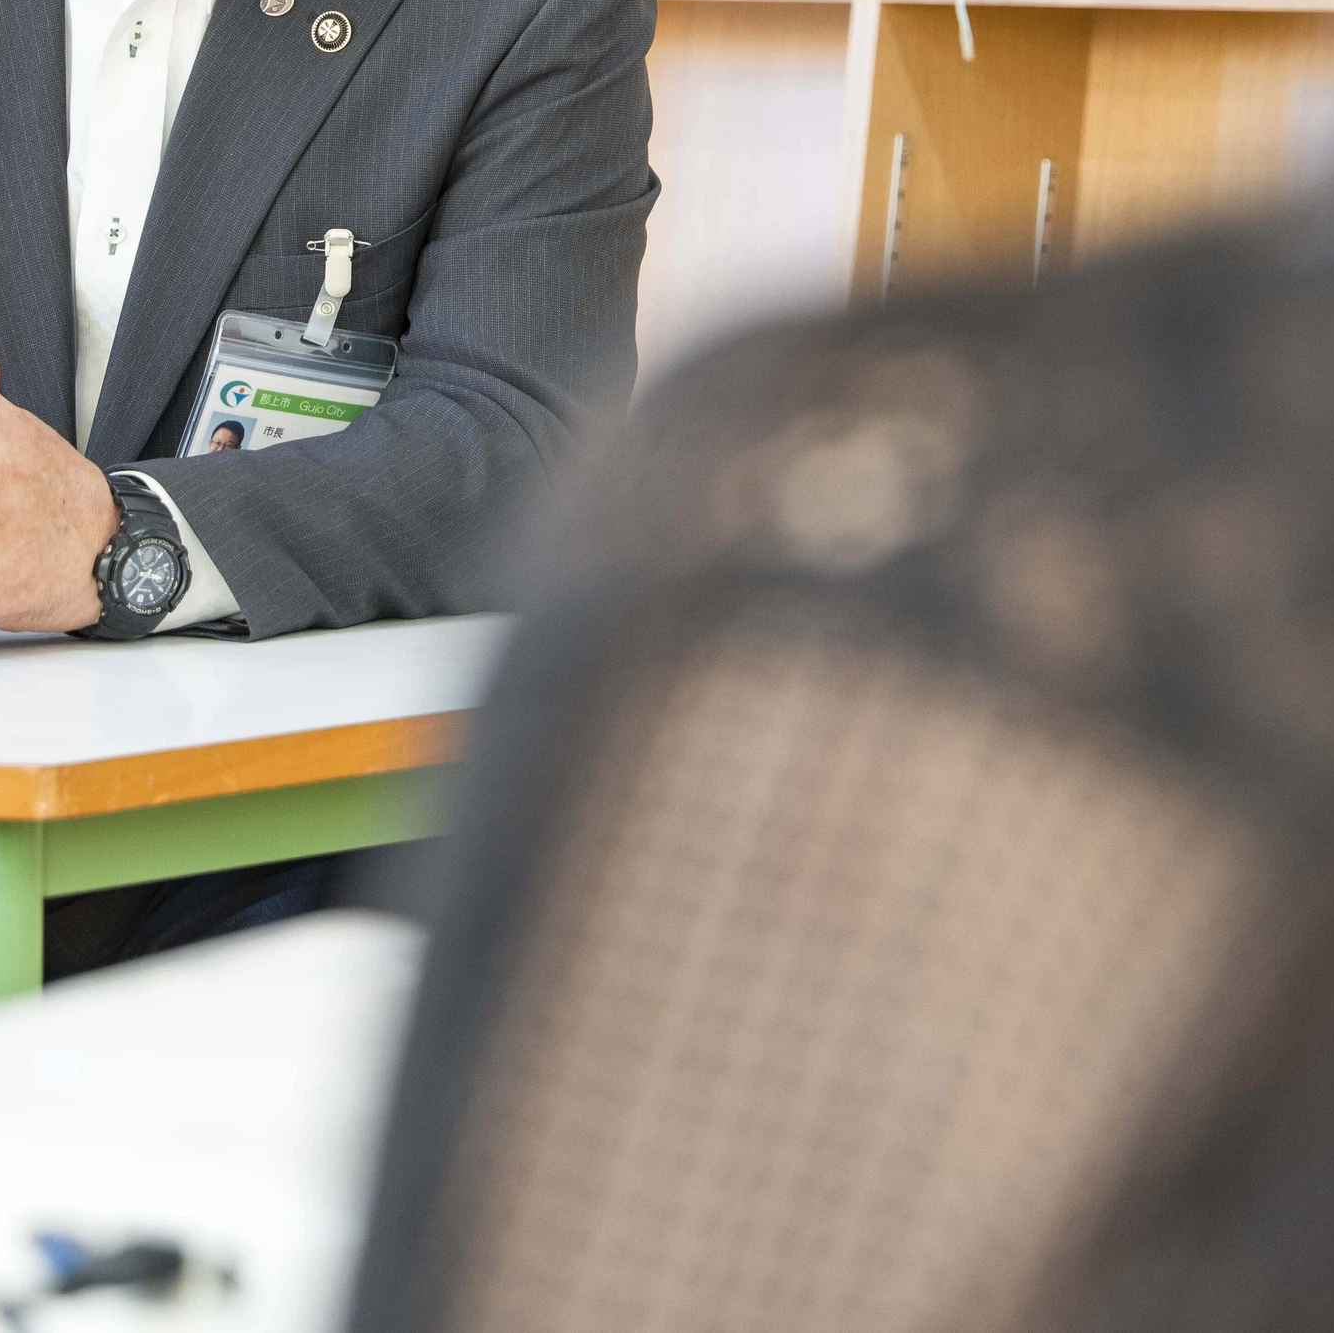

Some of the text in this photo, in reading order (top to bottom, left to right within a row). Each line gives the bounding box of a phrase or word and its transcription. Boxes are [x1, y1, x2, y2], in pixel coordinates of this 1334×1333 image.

[259, 393, 292, 408] 郡上市
[299, 400, 346, 418] Gujo City
[263, 426, 285, 439] 市長
[127, 602, 162, 615] G-SHOCK
